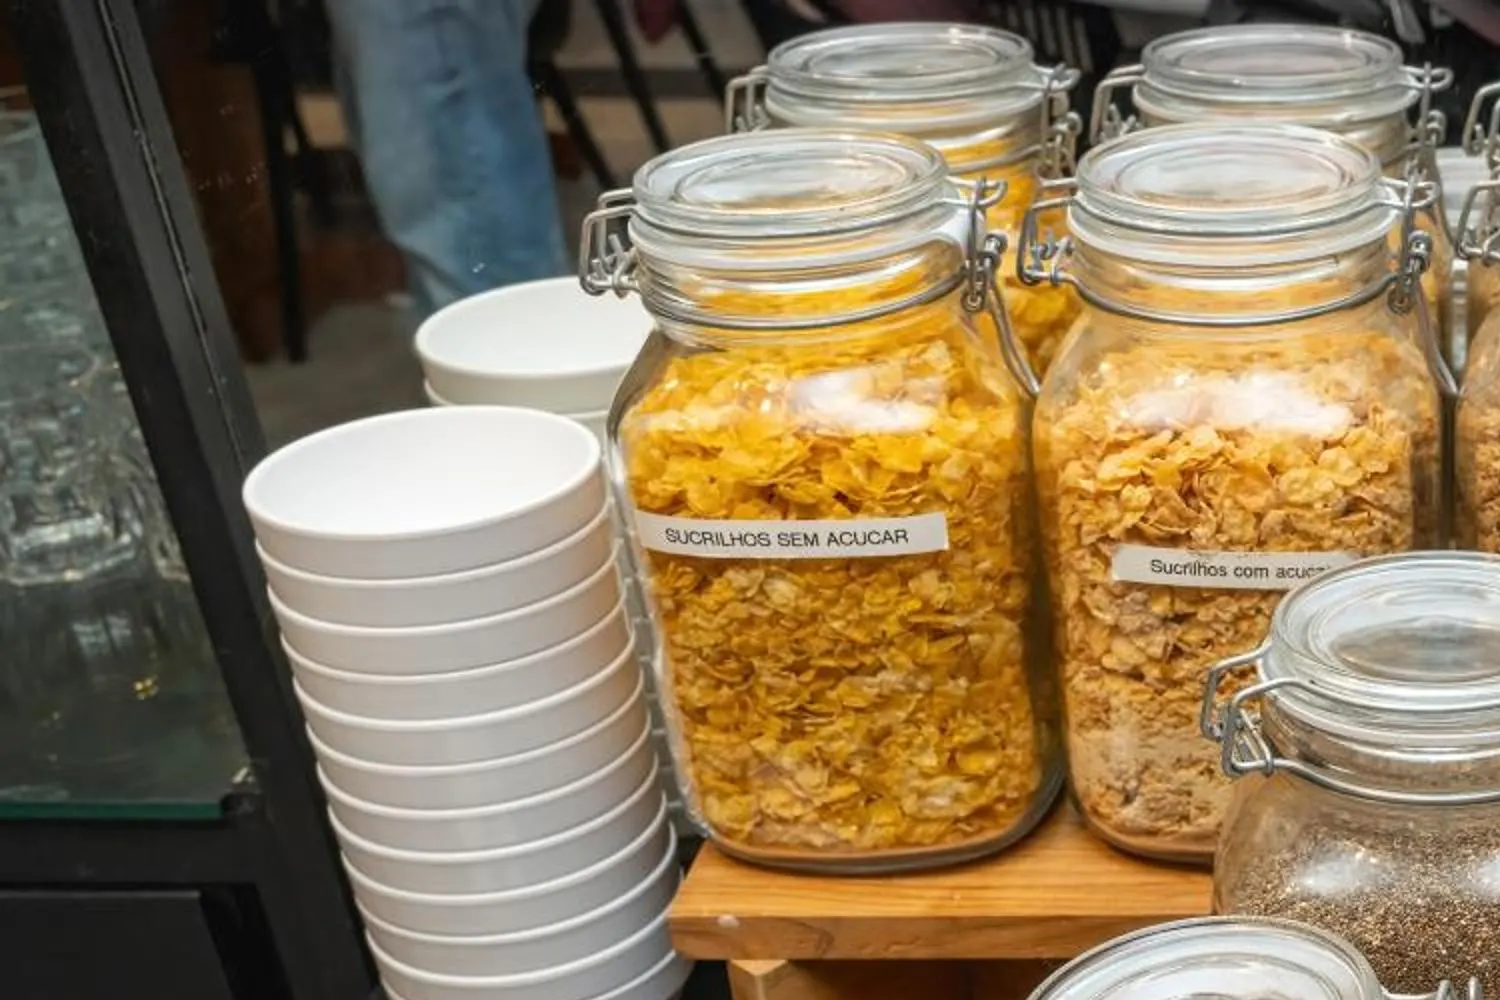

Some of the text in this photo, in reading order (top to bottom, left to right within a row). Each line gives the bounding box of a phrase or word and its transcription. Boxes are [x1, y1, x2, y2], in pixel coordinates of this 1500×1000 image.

[665, 527, 909, 548] SUCRILHOS SEM ACUCAR
[1150, 558, 1227, 578] Sucrilhos
[1233, 564, 1269, 580] com
